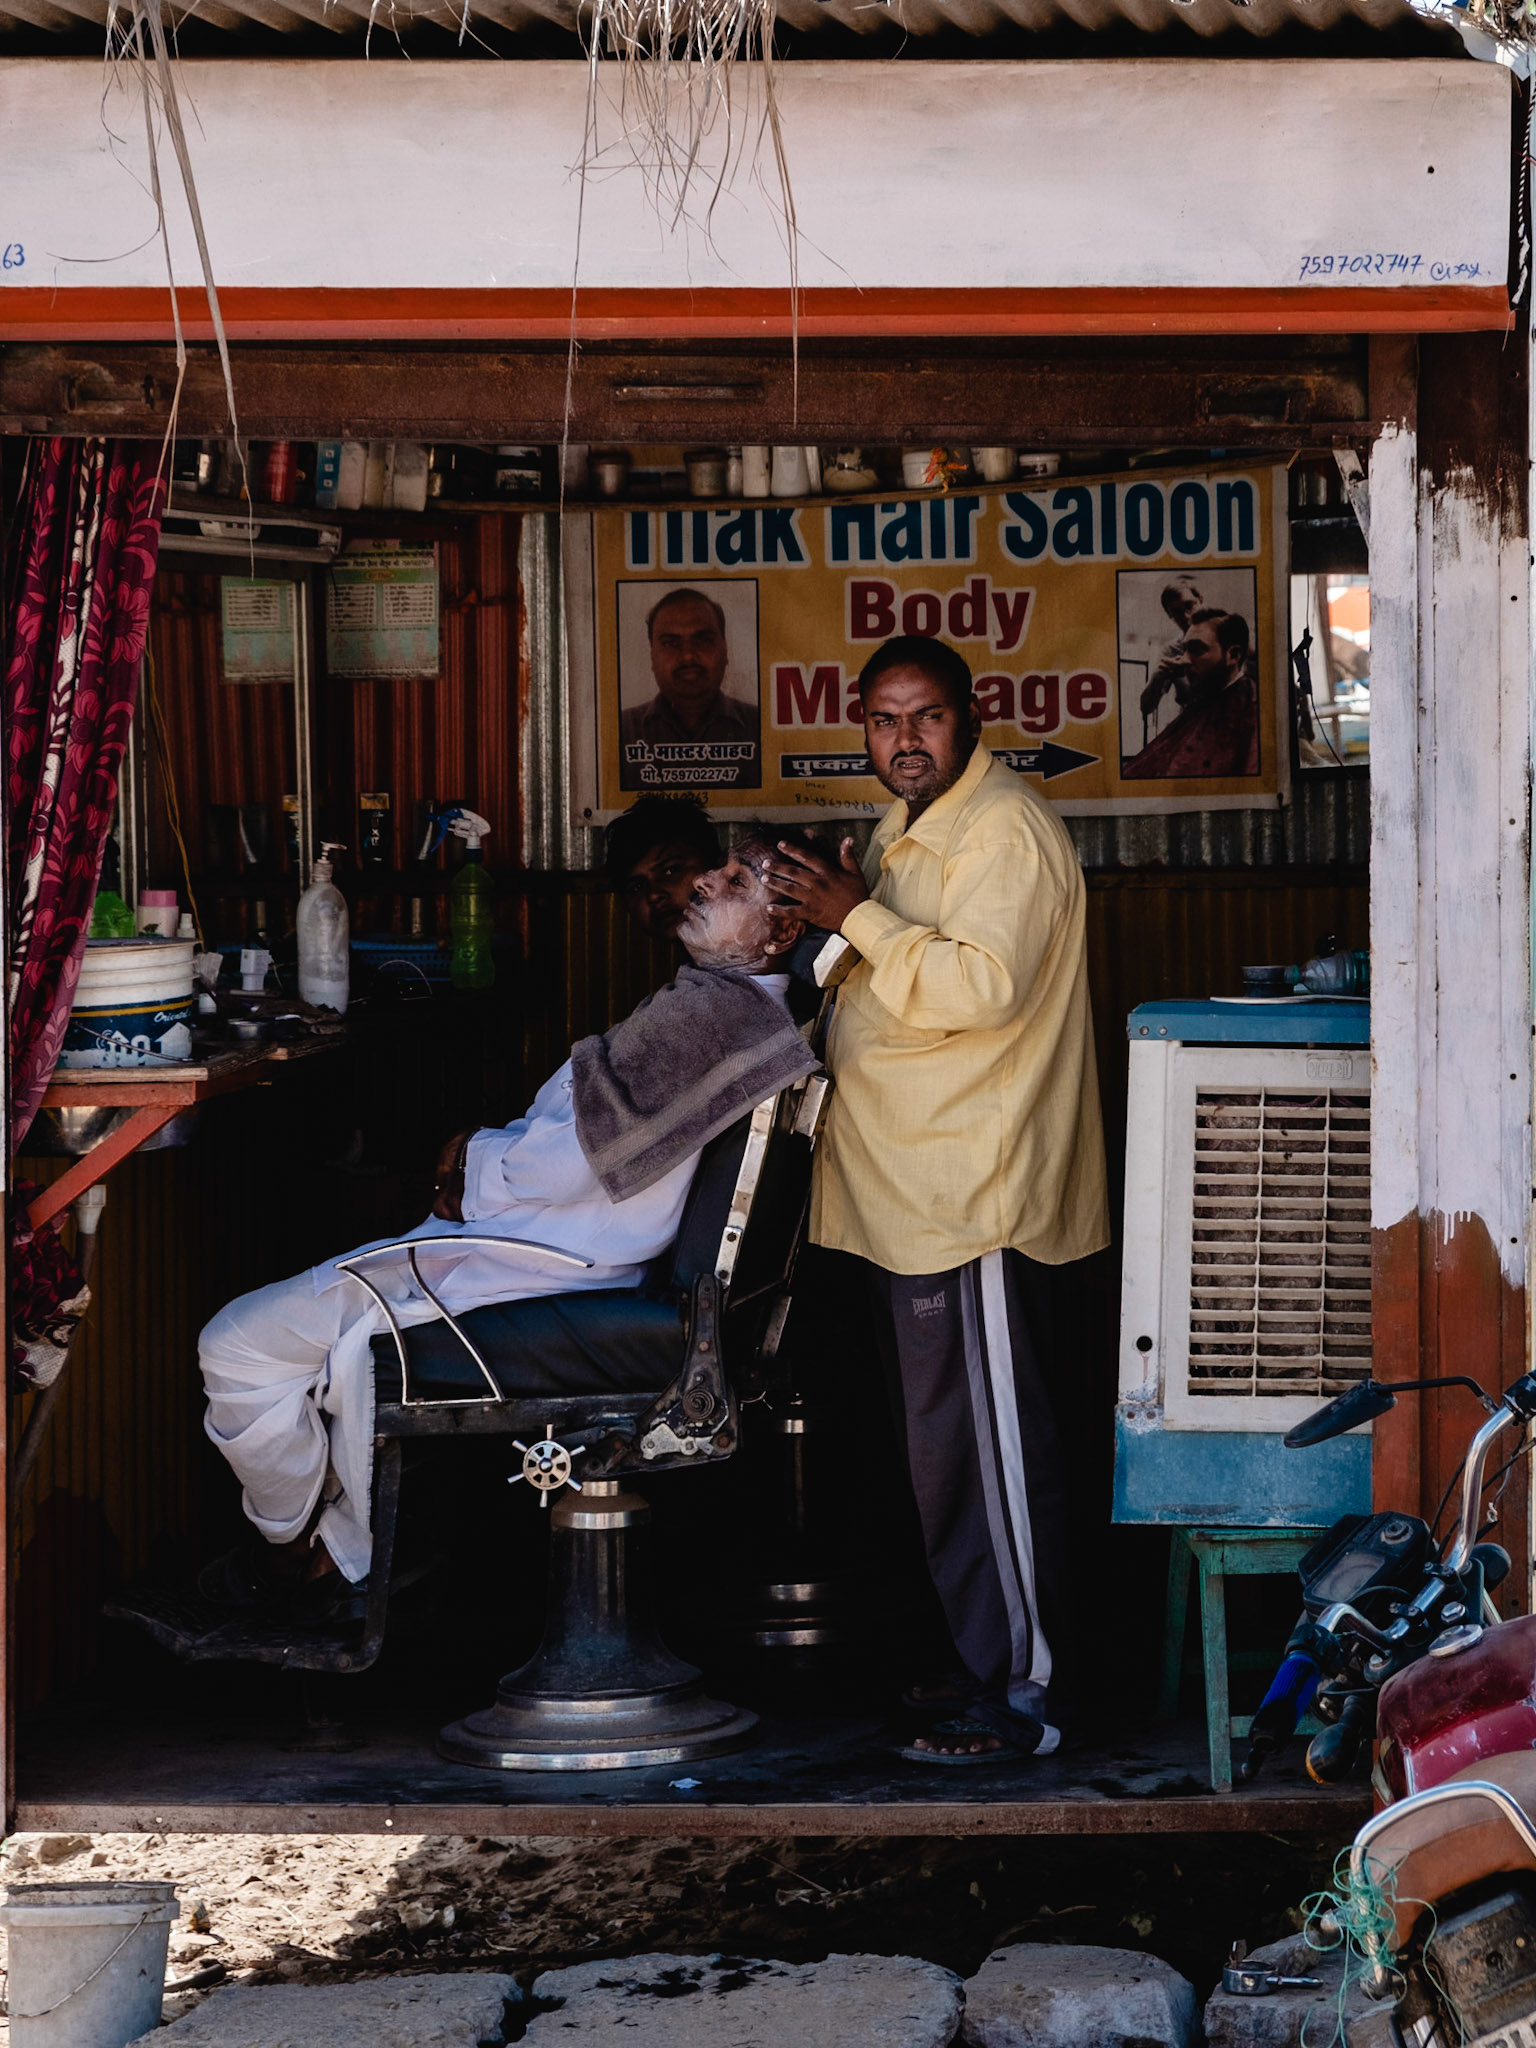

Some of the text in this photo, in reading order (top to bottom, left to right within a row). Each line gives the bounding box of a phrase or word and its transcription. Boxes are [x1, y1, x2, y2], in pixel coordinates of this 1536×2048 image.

[1299, 254, 1424, 281] 7597022747
[831, 497, 980, 562] Hair
[1005, 477, 1255, 560] Saloon
[849, 579, 1031, 651] Body
[776, 667, 1107, 734] Mage
[655, 742, 708, 763] मास्टर
[662, 766, 740, 783] 7597022747
[791, 758, 869, 777] पुष्कर
[911, 1290, 947, 1316] EVERLAST
